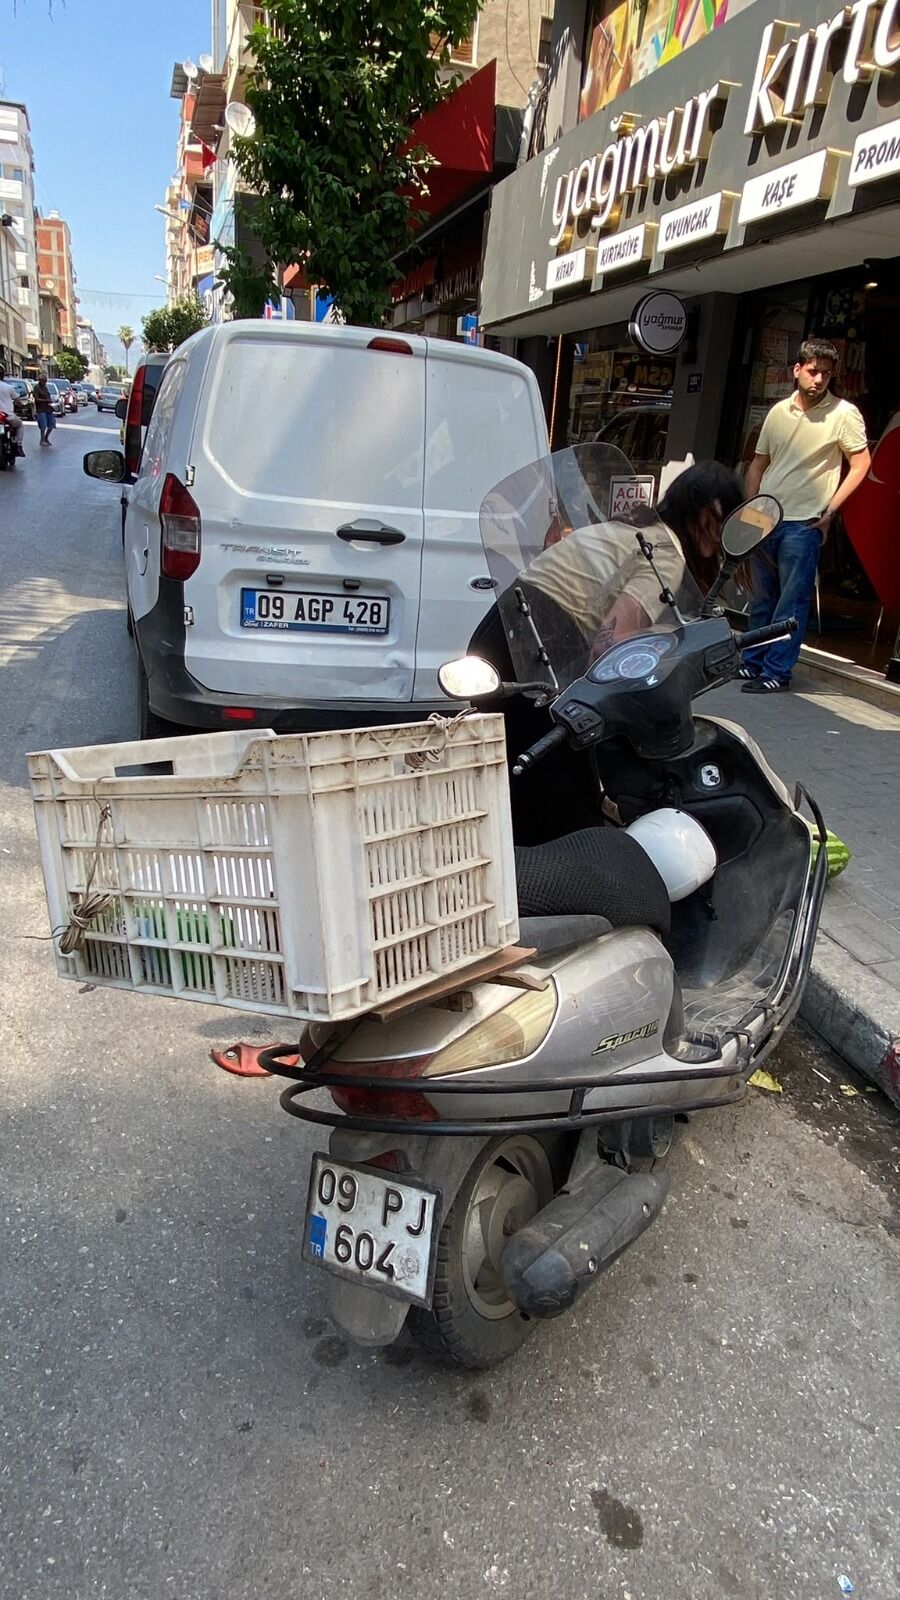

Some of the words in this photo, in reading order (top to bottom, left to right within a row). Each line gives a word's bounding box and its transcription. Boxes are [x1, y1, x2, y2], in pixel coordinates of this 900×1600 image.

[549, 84, 719, 246] yağmur
[761, 174, 798, 207] KAŞE
[665, 206, 712, 242] OYUNCAK
[600, 234, 640, 267] KIRTASİYE
[555, 260, 575, 282] KİTAP
[643, 313, 685, 327] yağmur
[220, 543, 302, 558] TRANSIT
[245, 607, 255, 616] TR
[258, 594, 284, 619] 09
[294, 597, 334, 622] AGP
[343, 600, 382, 625] 428
[263, 621, 289, 629] ZAFER
[318, 1168, 359, 1213] 09
[382, 1186, 428, 1236] PJ
[310, 1241, 322, 1257] TR
[334, 1224, 397, 1279] 604
